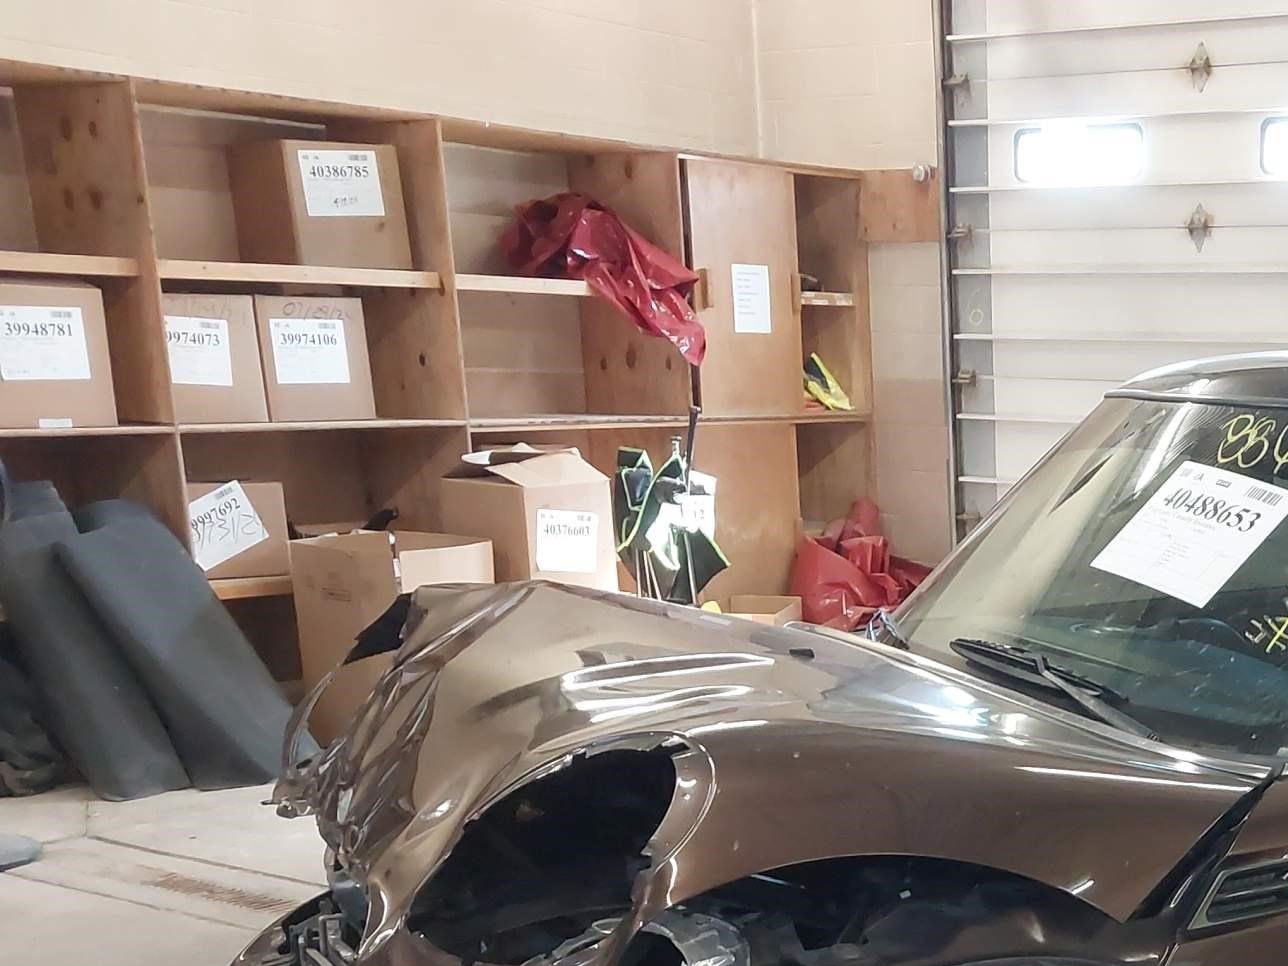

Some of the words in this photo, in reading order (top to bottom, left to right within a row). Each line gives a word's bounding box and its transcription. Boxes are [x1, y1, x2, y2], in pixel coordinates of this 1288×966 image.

[310, 165, 369, 178] 40386785
[5, 322, 72, 337] 39948781
[280, 333, 337, 345] 39974106
[1164, 488, 1261, 532] 40488653
